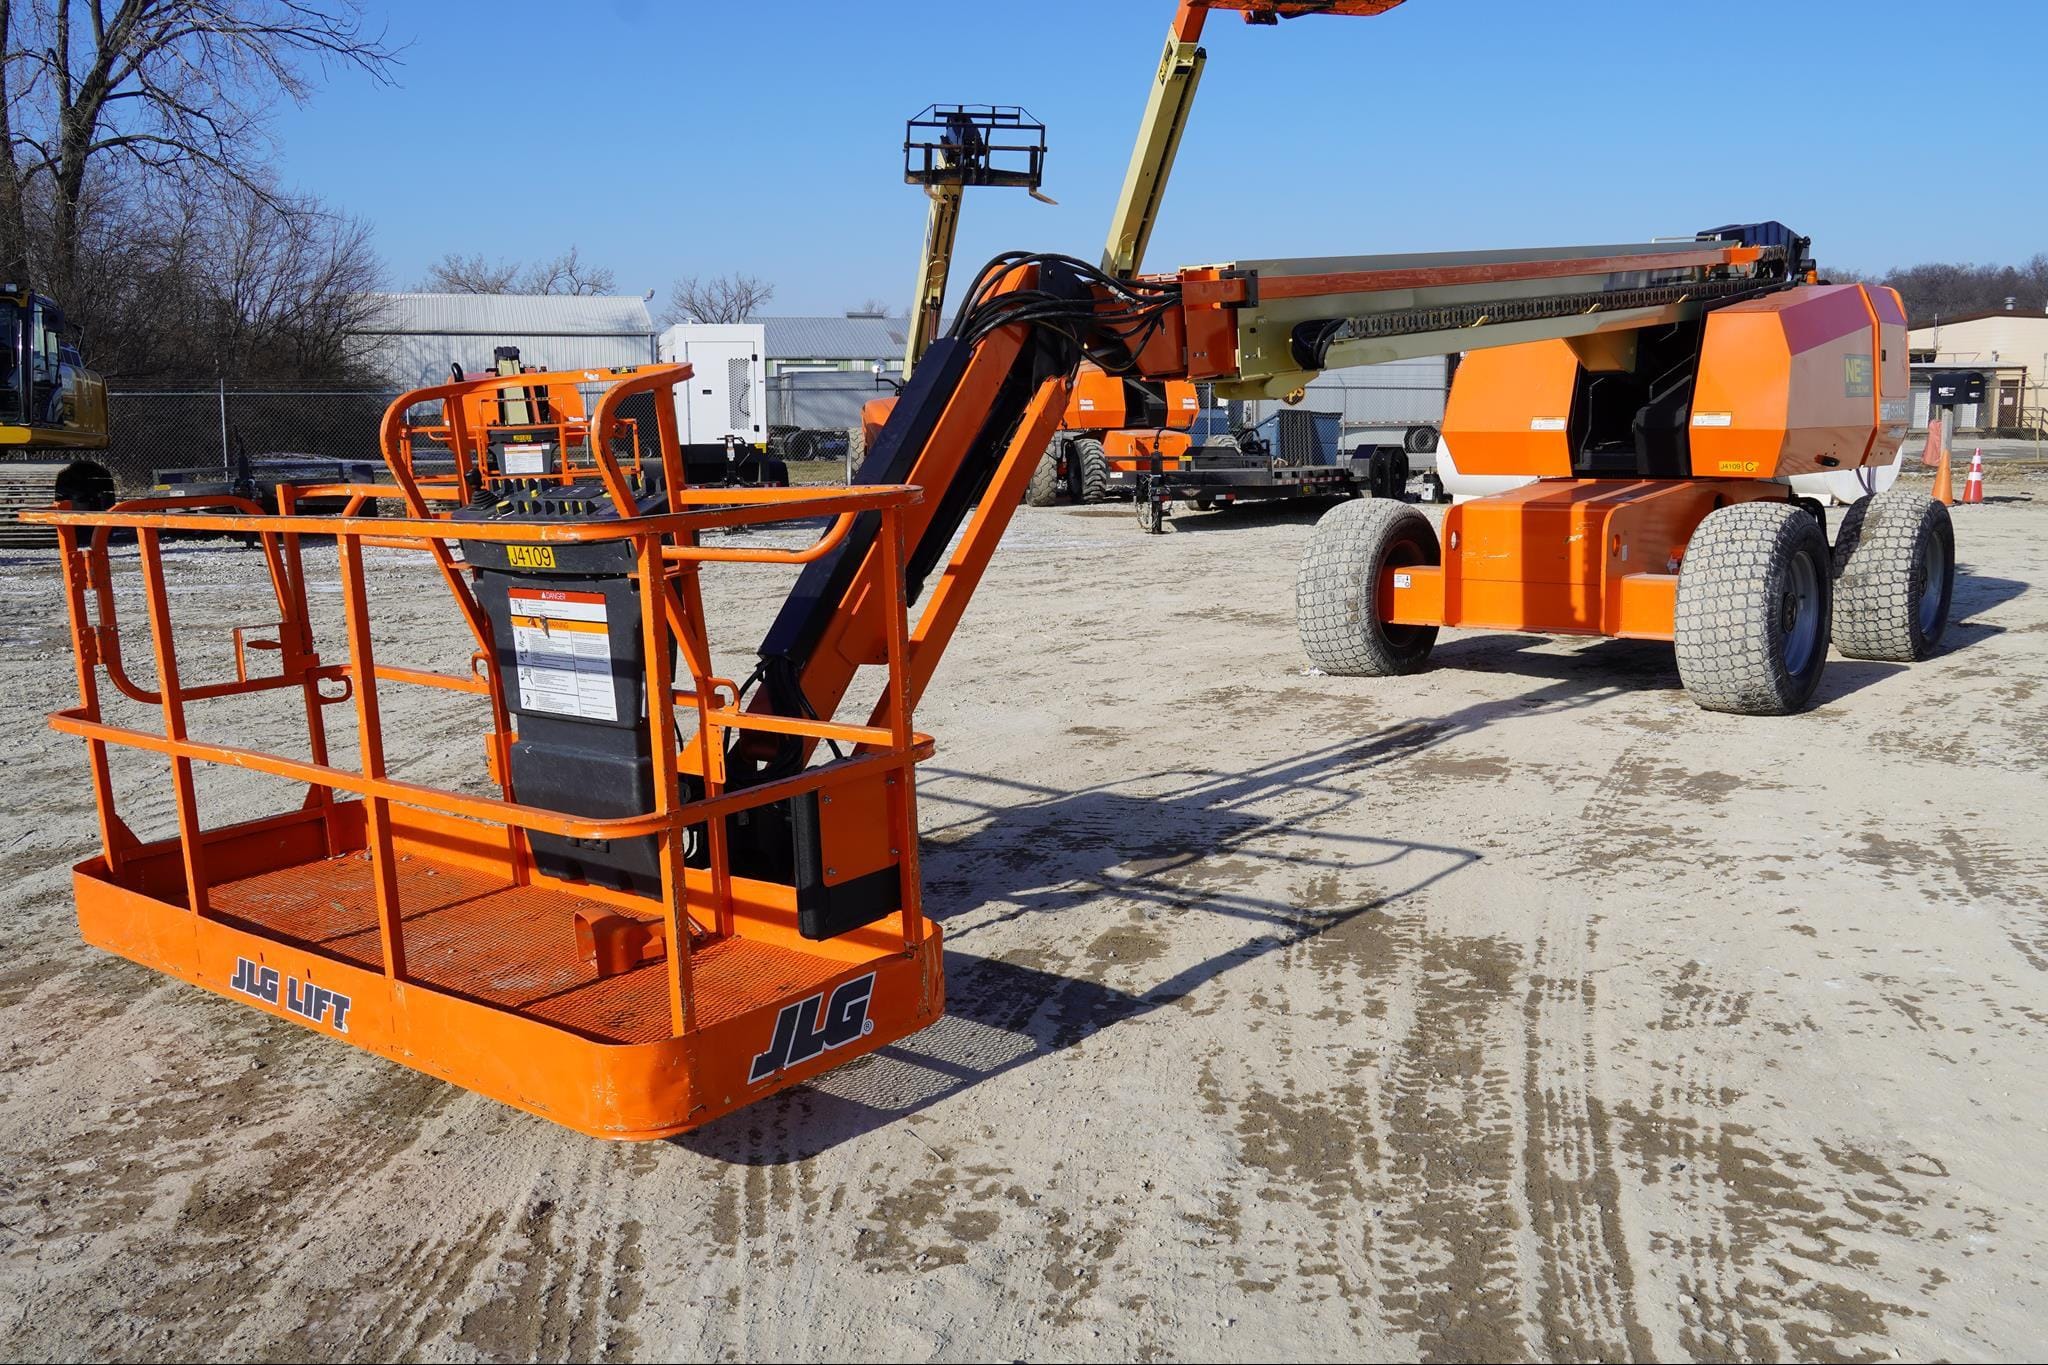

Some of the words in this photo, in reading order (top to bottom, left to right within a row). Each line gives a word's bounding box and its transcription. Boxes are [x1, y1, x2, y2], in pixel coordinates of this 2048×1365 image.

[511, 546, 552, 567] J4109
[545, 592, 566, 600] DANGER
[230, 956, 280, 1006] JLG
[286, 975, 352, 1034] LIFT
[747, 970, 877, 1086] JLG
